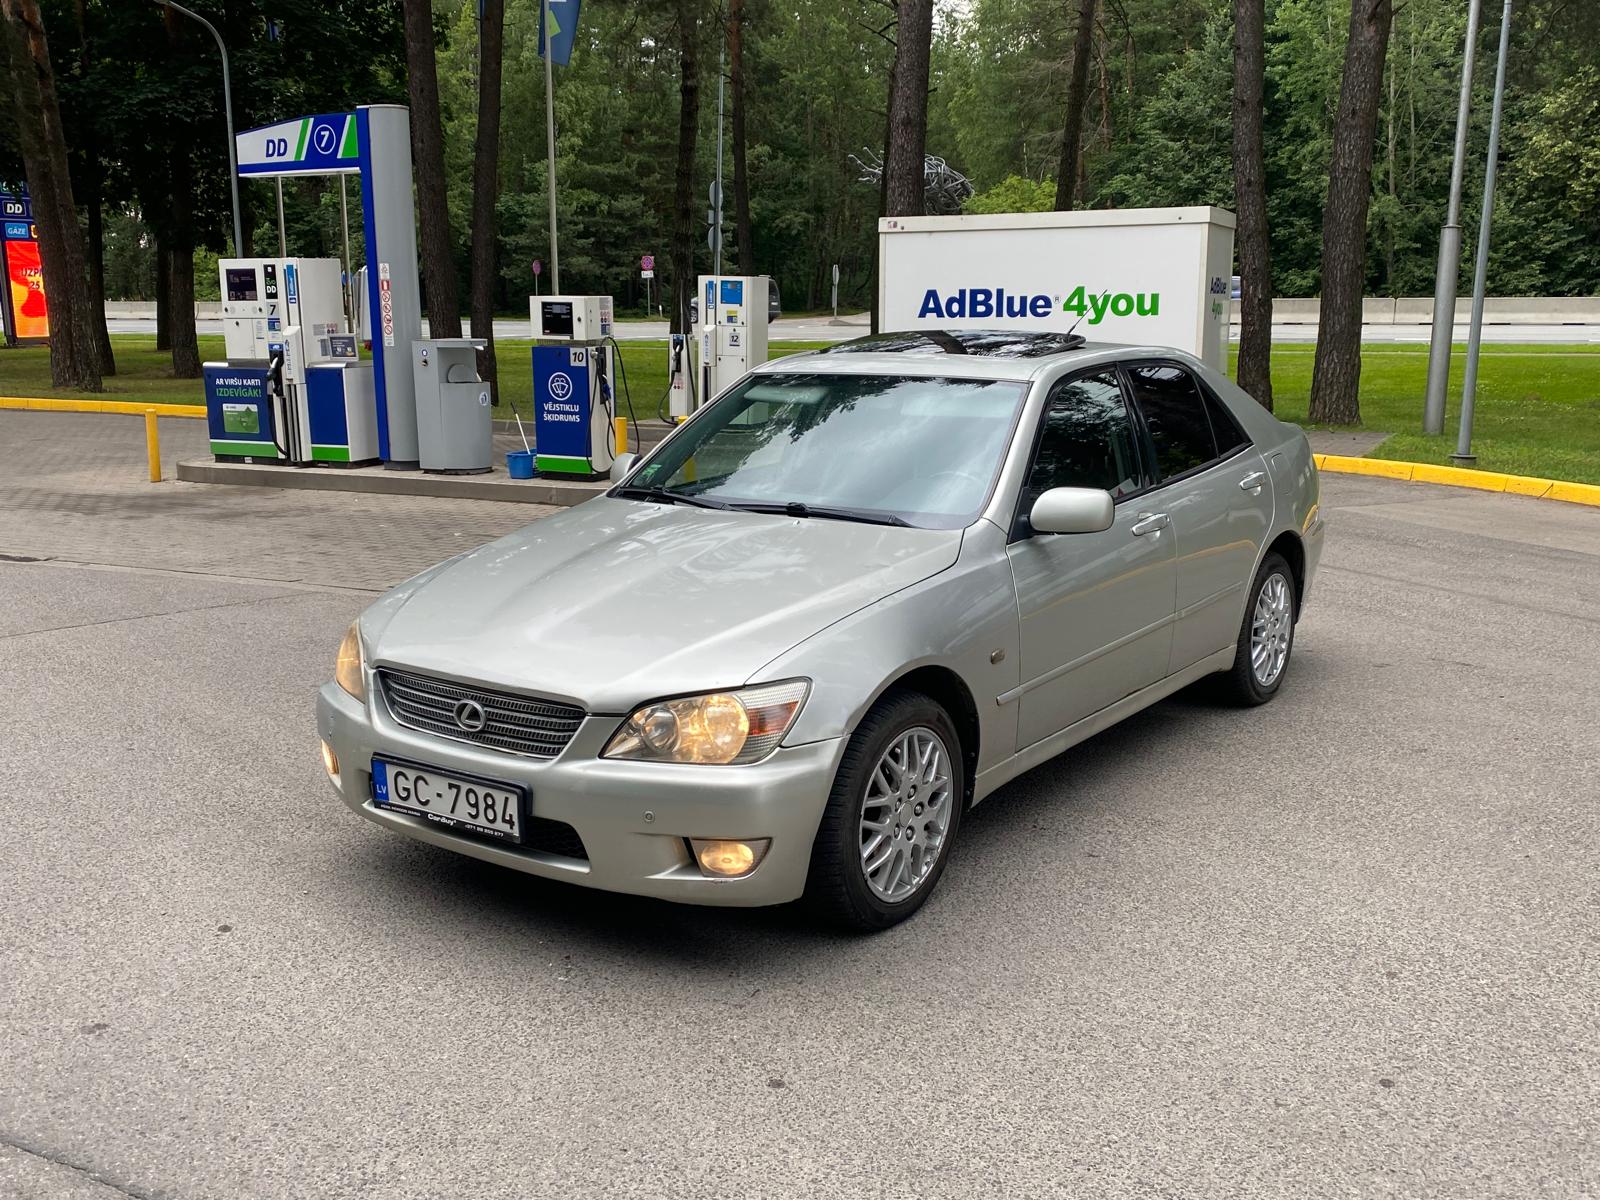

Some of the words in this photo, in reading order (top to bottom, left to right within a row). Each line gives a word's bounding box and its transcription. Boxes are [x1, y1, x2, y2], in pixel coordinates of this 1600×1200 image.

[320, 130, 330, 148] 7
[265, 139, 288, 158] DD
[6, 203, 23, 214] DD
[266, 285, 277, 294] DD
[1210, 276, 1227, 295] AdBlue
[269, 304, 277, 316] 7
[1063, 286, 1160, 325] 4you
[731, 335, 739, 343] 12
[572, 351, 584, 363] 10
[215, 377, 225, 386] AR
[224, 377, 243, 387] VIRŠU
[242, 378, 261, 387] KARTI
[216, 387, 262, 398] IZDEVĪGĀK!
[543, 401, 580, 412] VĒJSTIKLU
[376, 784, 387, 794] LV
[393, 770, 516, 830] GC-7984
